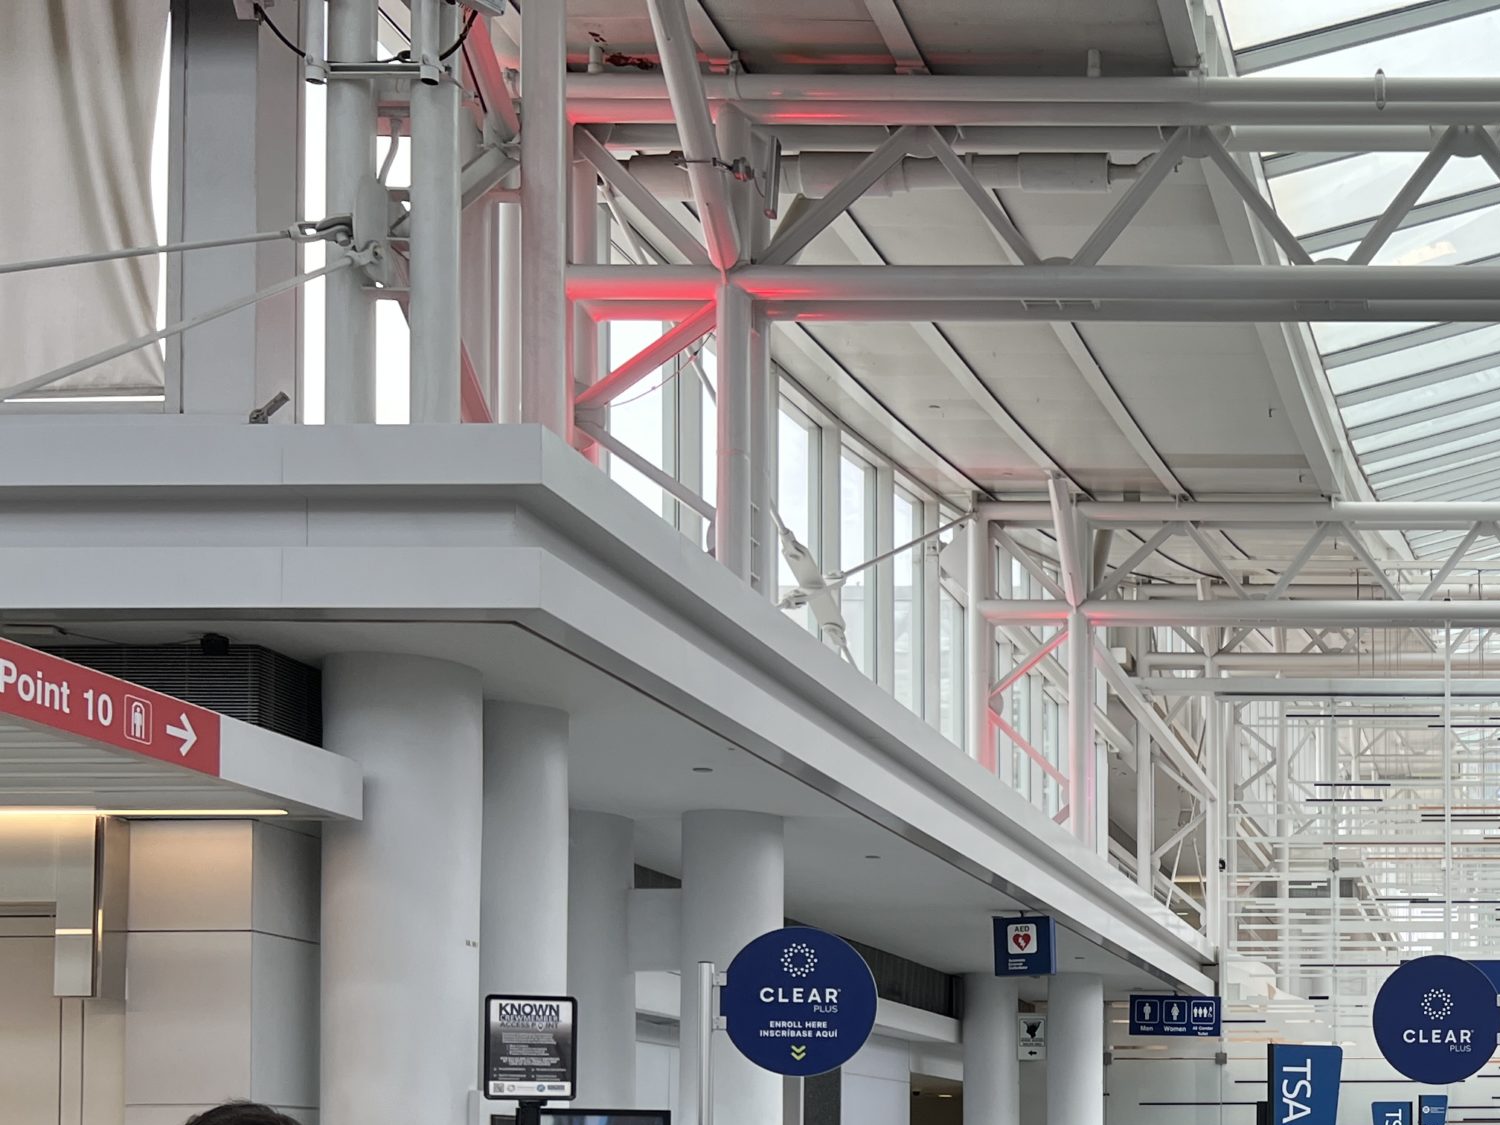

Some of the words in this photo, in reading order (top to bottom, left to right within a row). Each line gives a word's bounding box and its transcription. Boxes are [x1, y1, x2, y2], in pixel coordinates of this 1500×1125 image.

[0, 659, 71, 714] Point
[83, 688, 113, 727] 10
[1014, 925, 1030, 933] AED
[760, 987, 838, 1004] CLEAR
[499, 1002, 560, 1021] KNOWN
[813, 1004, 839, 1013] PLUS
[769, 1020, 803, 1029] ENROLL
[805, 1021, 828, 1029] HERE
[1163, 1025, 1187, 1033] Women
[760, 1028, 813, 1038] INSCRÍBASE
[815, 1028, 838, 1038] AQUÍ
[1402, 1029, 1472, 1044] CLEAR
[1449, 1044, 1472, 1053] PLUS
[1281, 1058, 1312, 1124] TSA
